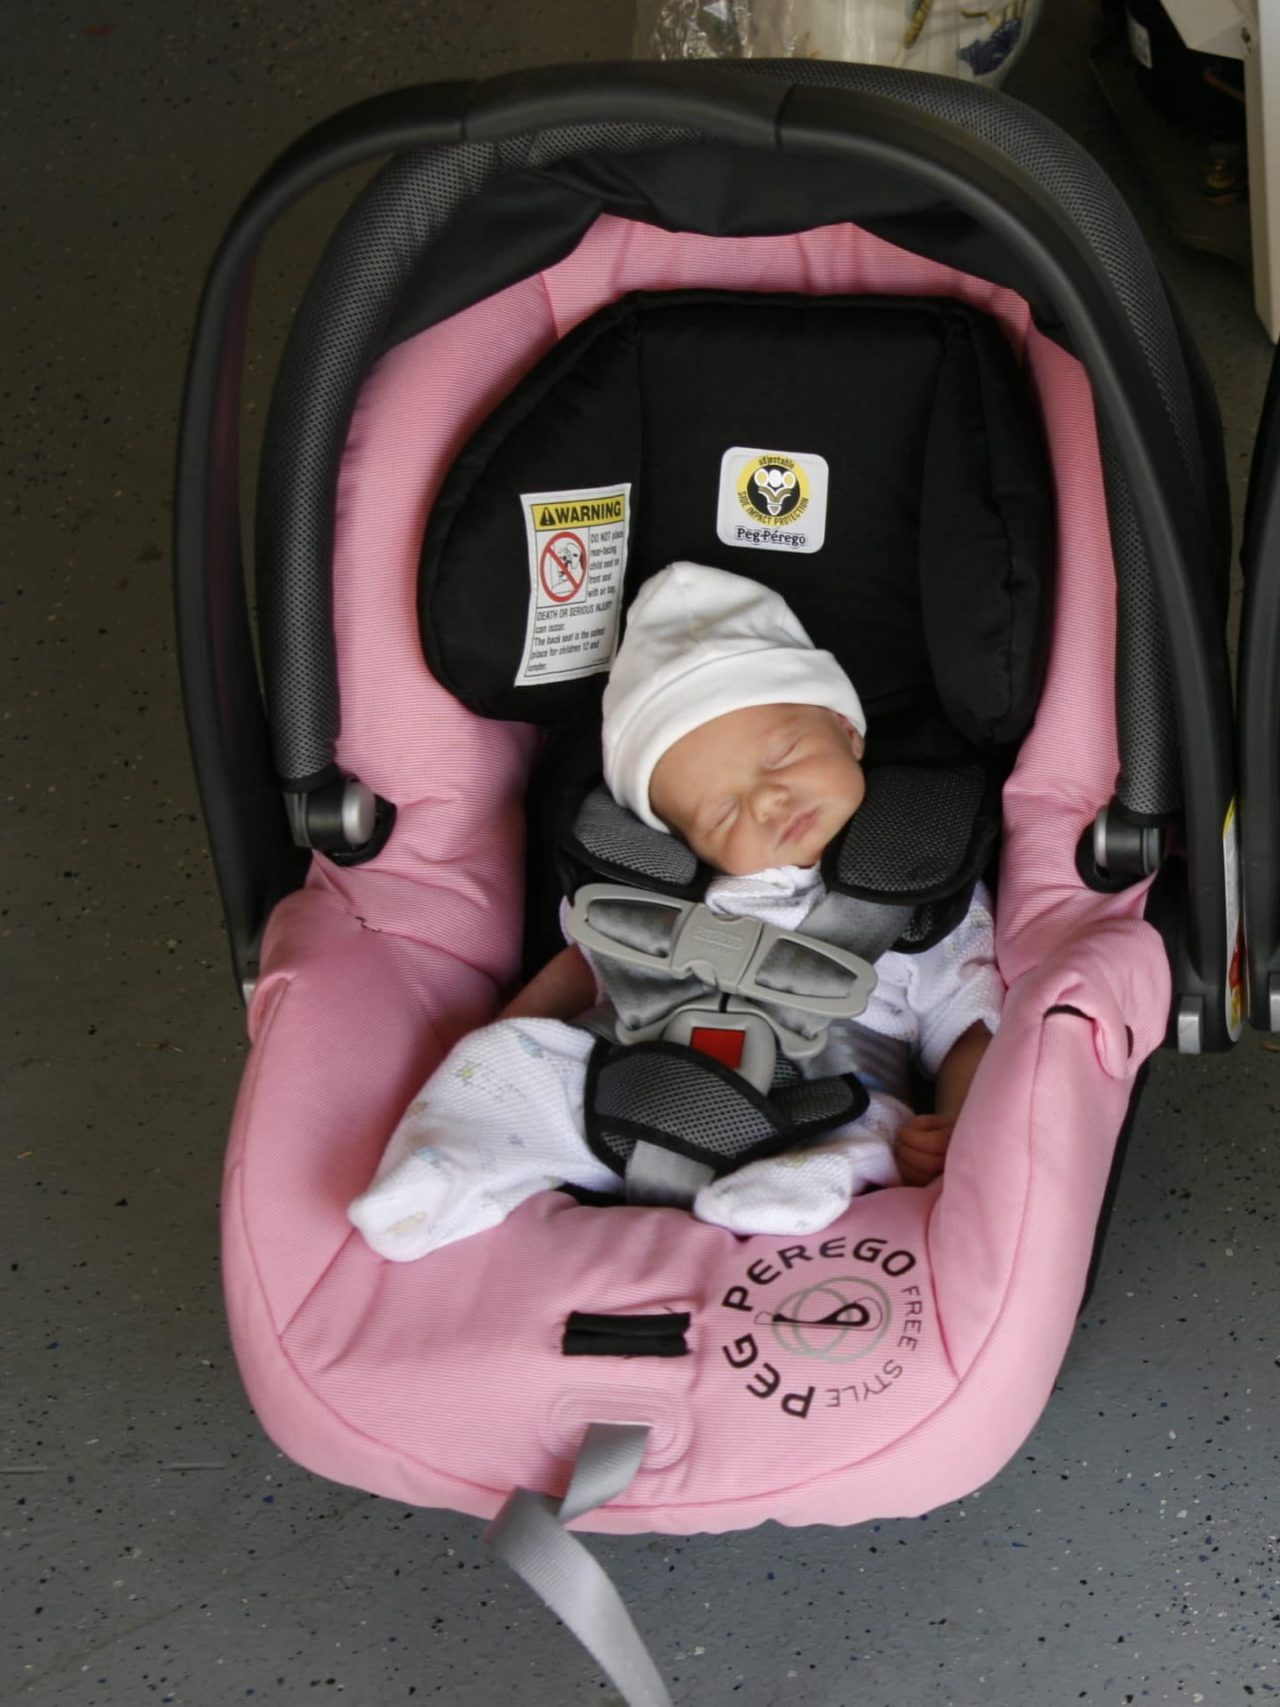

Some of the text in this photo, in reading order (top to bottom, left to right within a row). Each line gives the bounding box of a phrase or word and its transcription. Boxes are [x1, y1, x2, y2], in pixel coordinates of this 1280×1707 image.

[555, 501, 621, 525] WARNING
[738, 491, 809, 525] SIDE IMPACT PROTECTION
[537, 610, 558, 621] DEATH
[559, 607, 568, 618] OR
[569, 604, 594, 617] SERIOUS
[535, 637, 545, 646] The
[721, 1236, 917, 1420] PEG PEREGO
[825, 1285, 923, 1408] FREE STYLE
